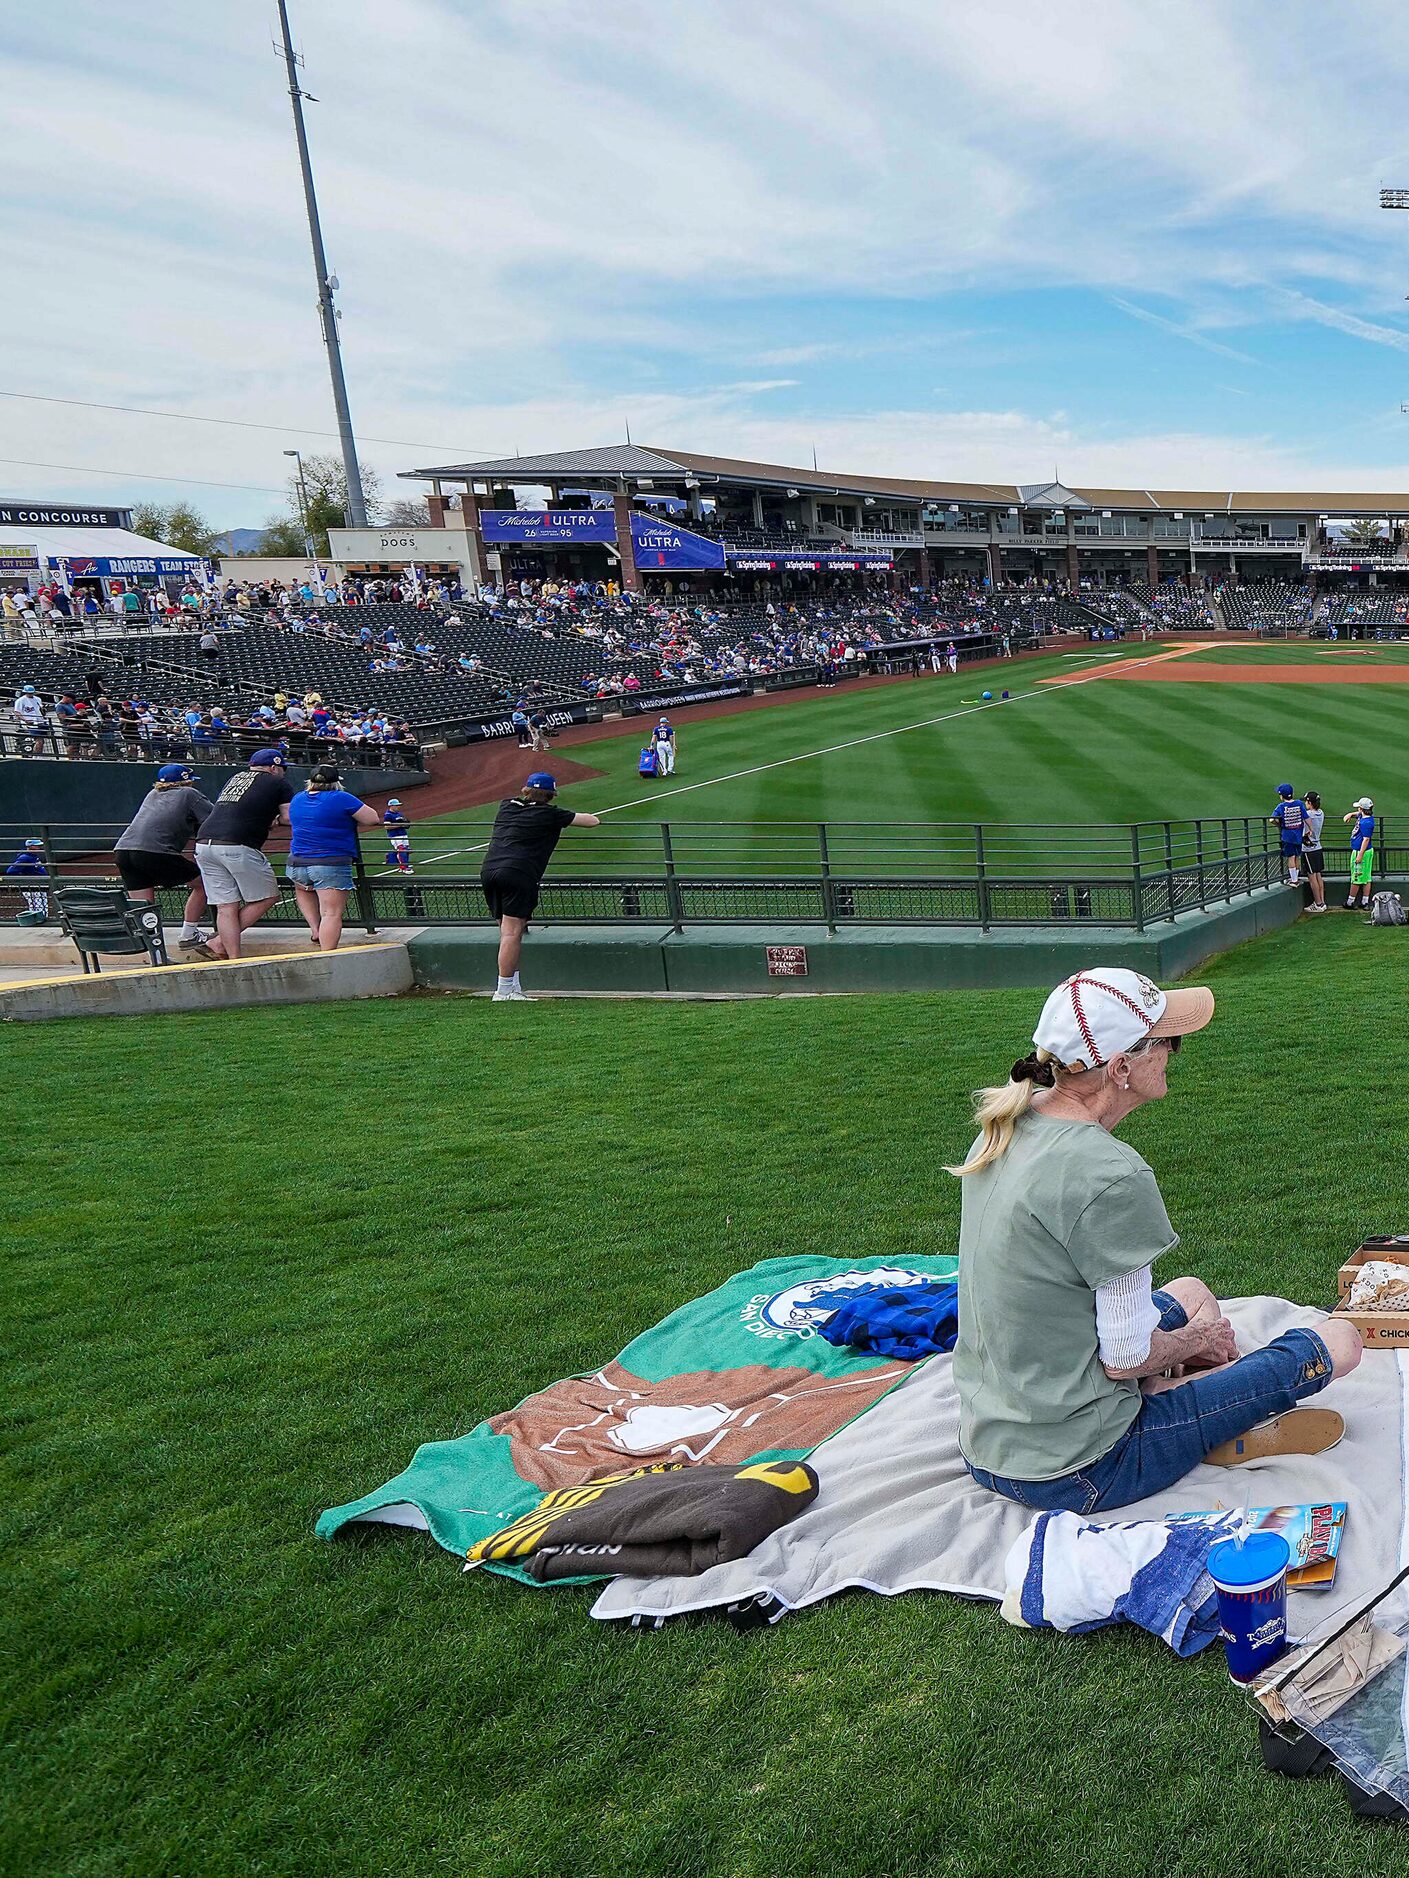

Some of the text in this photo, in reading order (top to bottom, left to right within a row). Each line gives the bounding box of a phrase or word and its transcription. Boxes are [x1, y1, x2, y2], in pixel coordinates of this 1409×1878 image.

[18, 511, 108, 524] CONCOURSE
[498, 514, 598, 526] Michelob ULTRA
[524, 529, 572, 537] 26 95
[380, 538, 416, 547] DOGS
[638, 537, 682, 547] ULTRA
[109, 559, 156, 573] RANGERS
[160, 561, 183, 571] TEAM
[481, 711, 574, 738] BARRI UEEN
[659, 731, 667, 739] 18
[739, 1293, 770, 1323] SAN
[1311, 1504, 1334, 1546] PLAY
